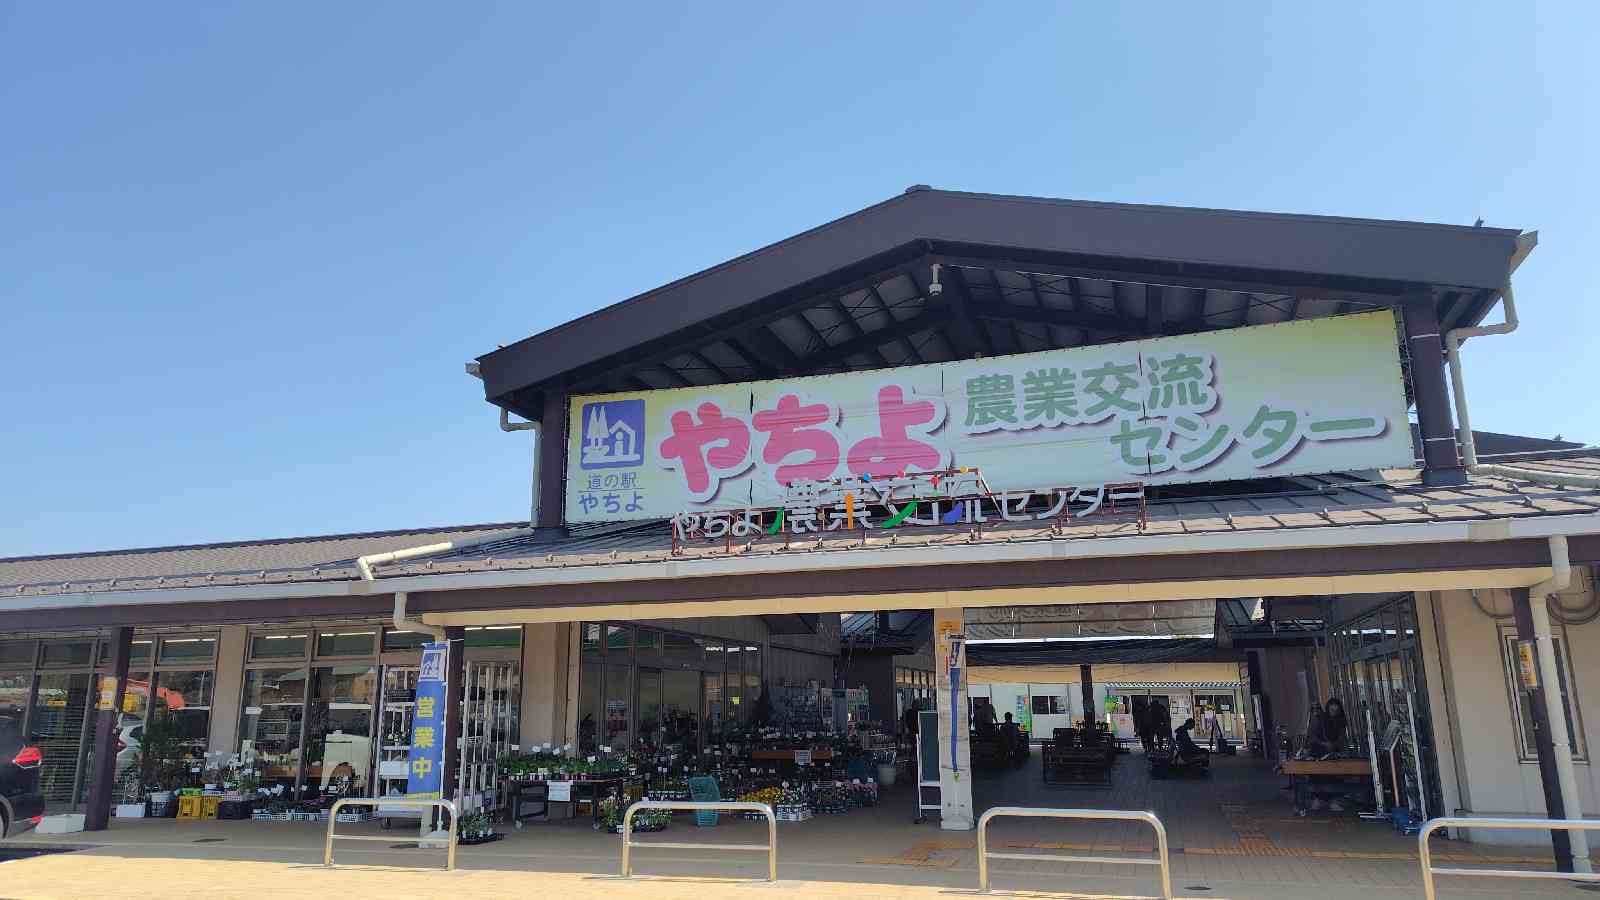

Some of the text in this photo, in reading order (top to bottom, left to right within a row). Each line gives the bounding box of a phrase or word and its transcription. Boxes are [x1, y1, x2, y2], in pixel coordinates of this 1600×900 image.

[964, 353, 1208, 427] 農業交流
[659, 384, 941, 494] やちよ
[1110, 404, 1375, 466] センター
[578, 490, 644, 515] やちよ
[587, 472, 639, 490] 道の駅
[412, 696, 435, 779] 営業中
